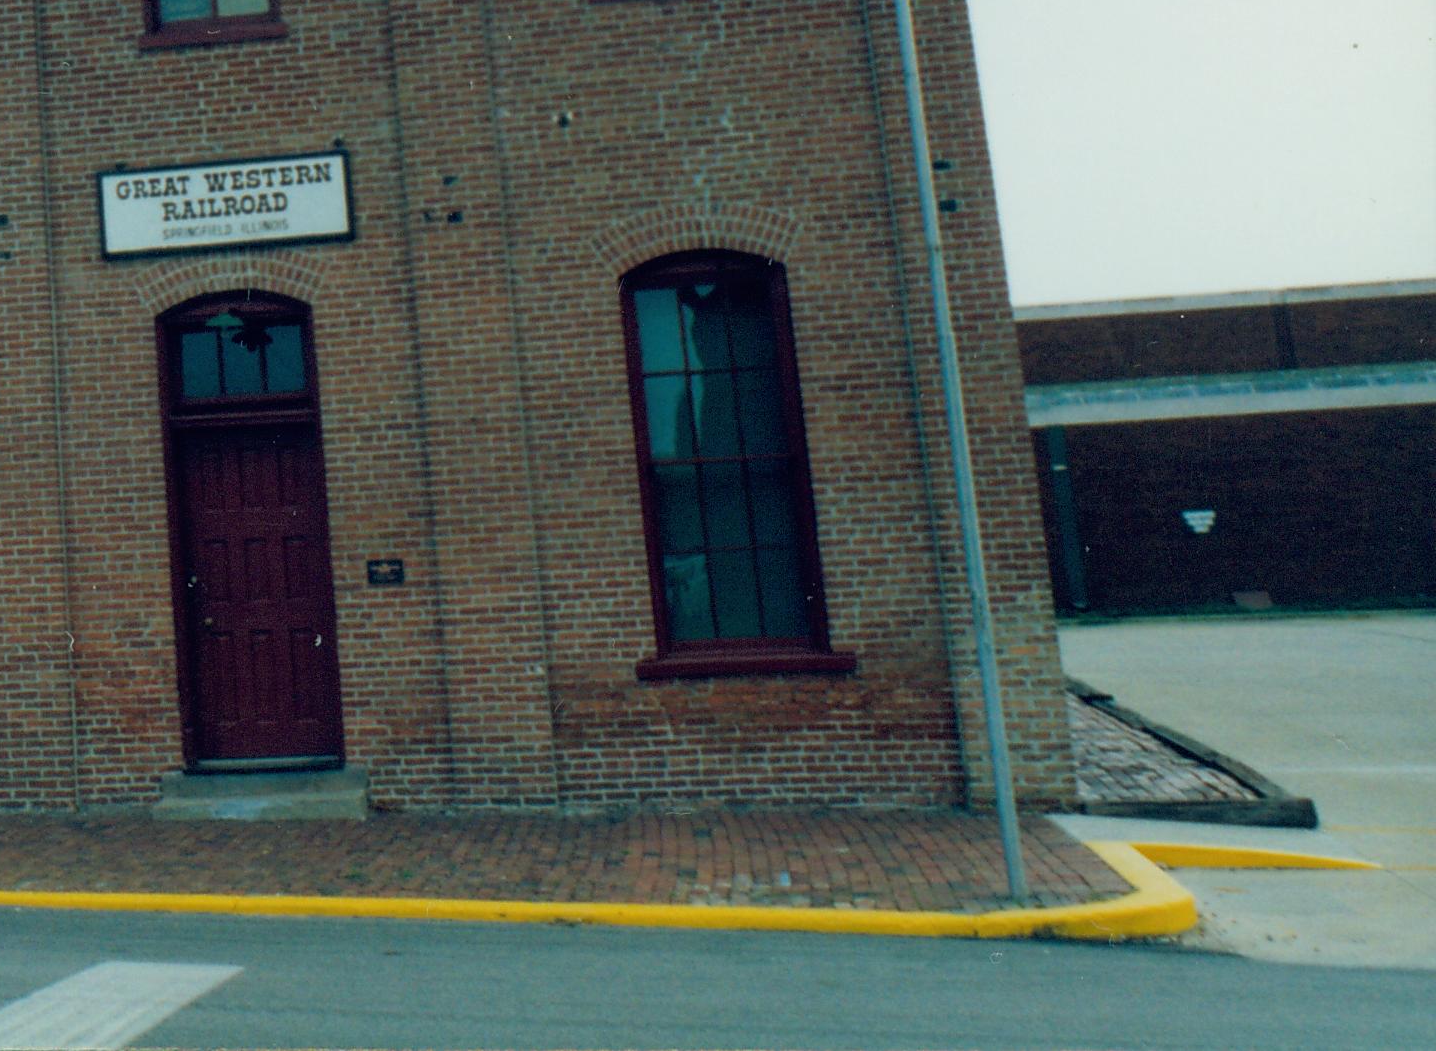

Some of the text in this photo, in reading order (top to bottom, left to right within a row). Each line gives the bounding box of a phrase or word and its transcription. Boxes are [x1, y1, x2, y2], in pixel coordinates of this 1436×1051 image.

[116, 163, 332, 200] GREAT WESTERN
[162, 192, 289, 221] RAILROAD
[241, 218, 289, 234] ILLINOIS
